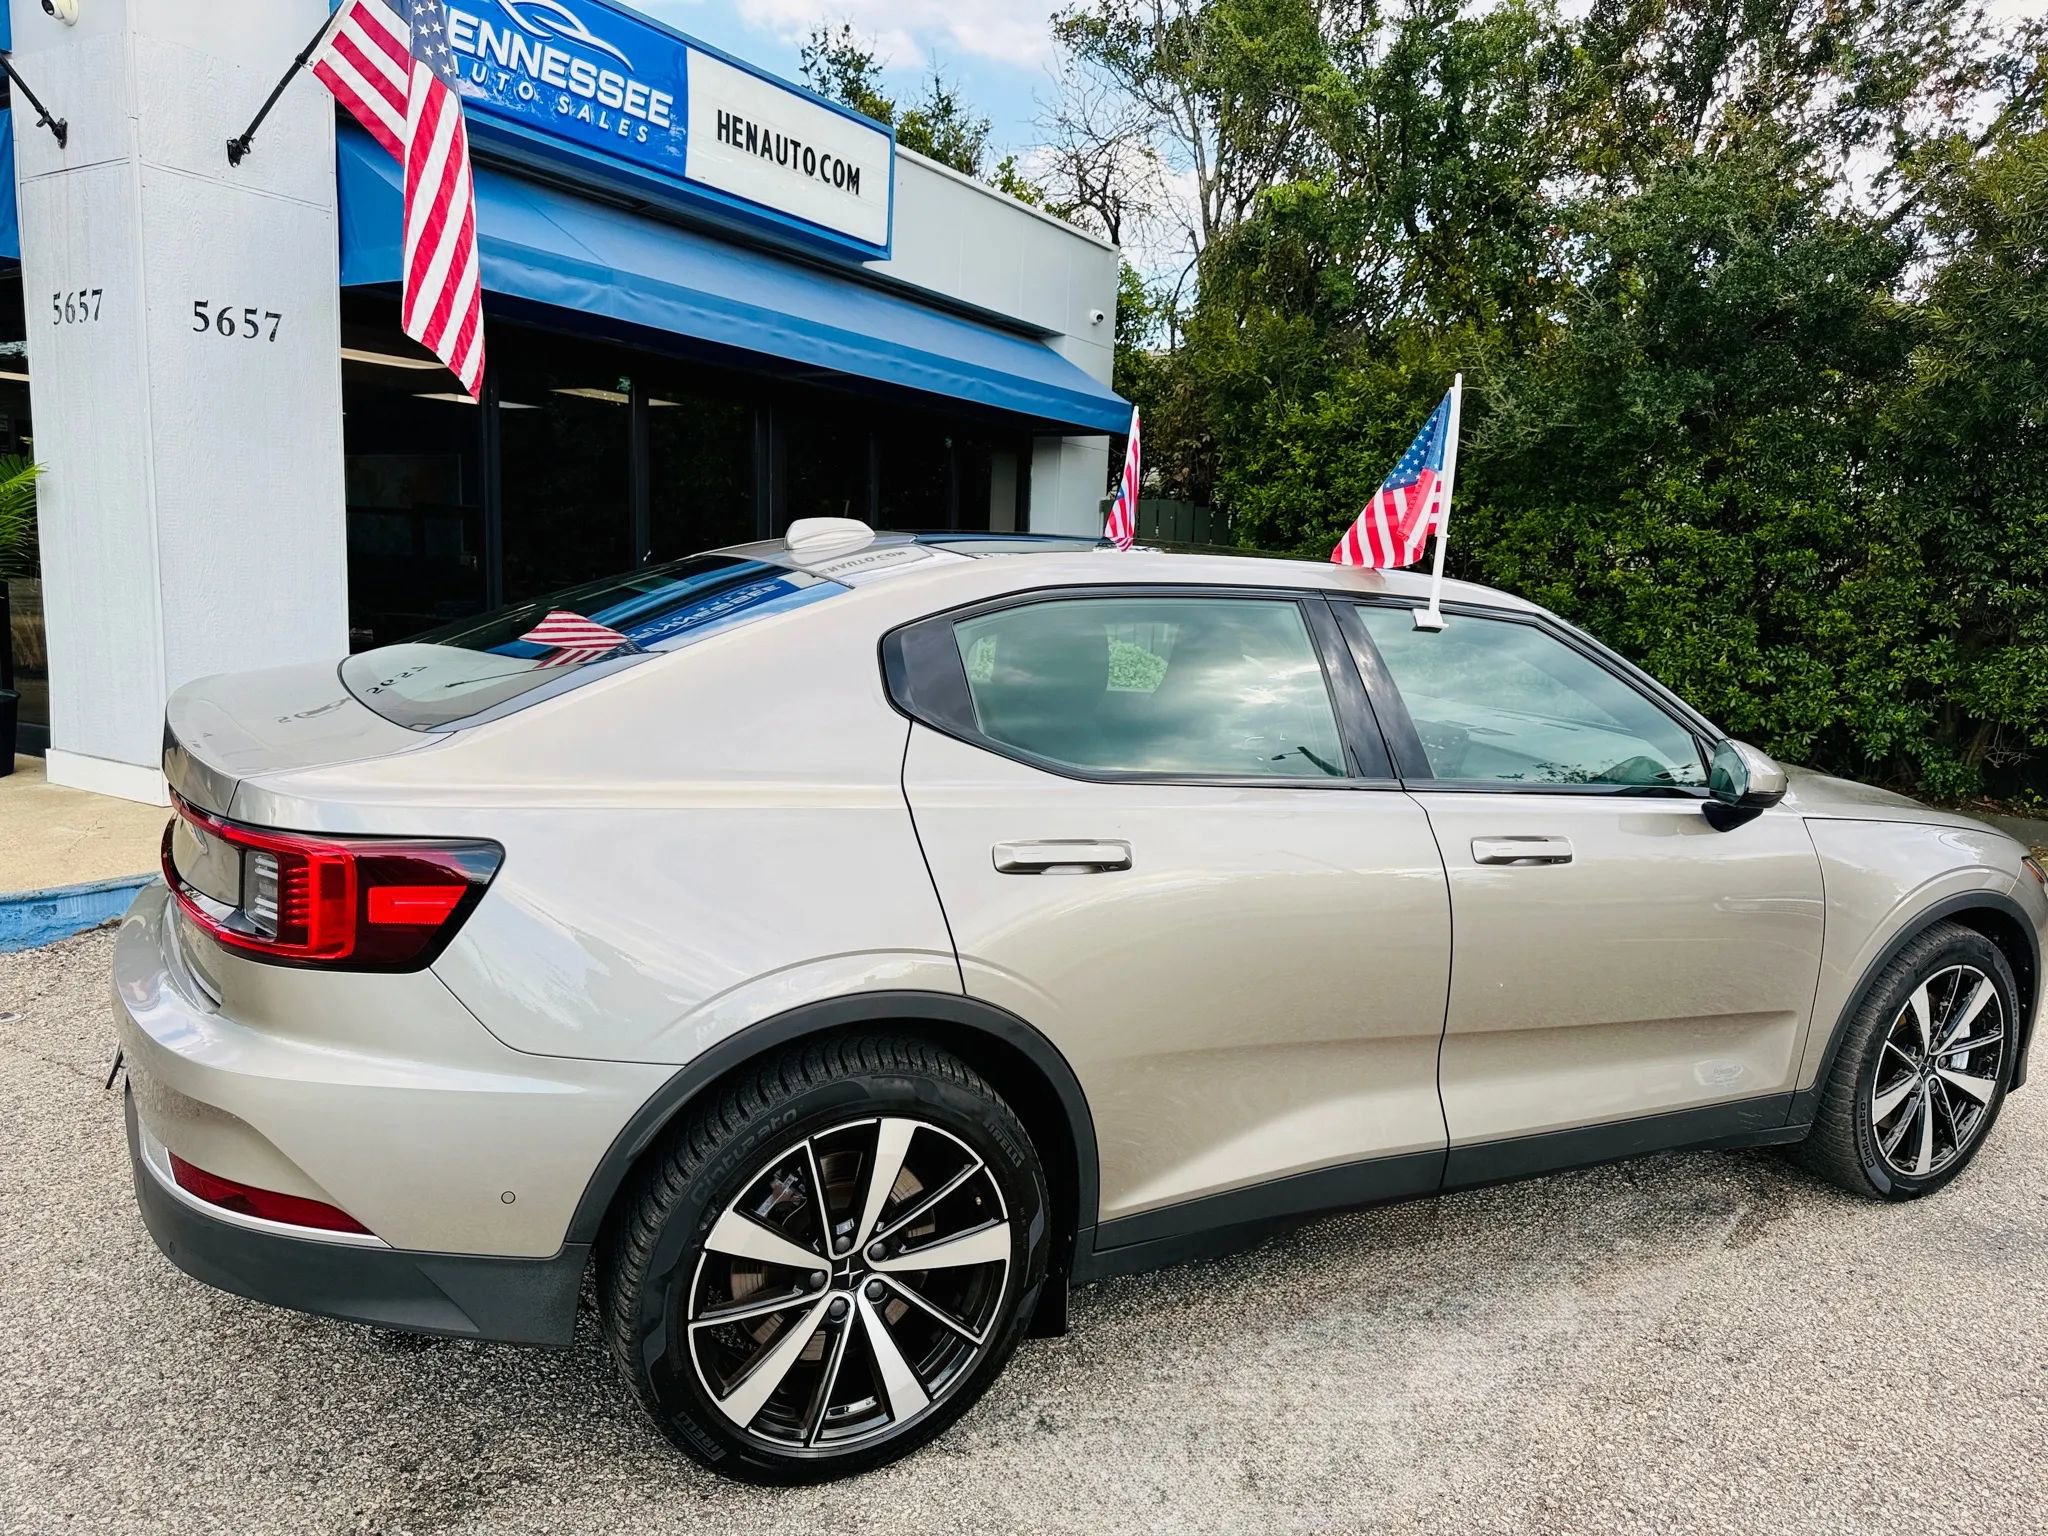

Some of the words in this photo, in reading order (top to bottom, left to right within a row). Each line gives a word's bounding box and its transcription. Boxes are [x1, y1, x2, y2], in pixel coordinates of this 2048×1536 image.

[443, 4, 673, 128] ENNESSEE
[557, 96, 648, 142] SALES
[53, 288, 103, 325] 5657
[193, 300, 282, 342] 5657
[982, 1120, 1026, 1169] PIRELLI
[1859, 1096, 1876, 1168] Cinturato
